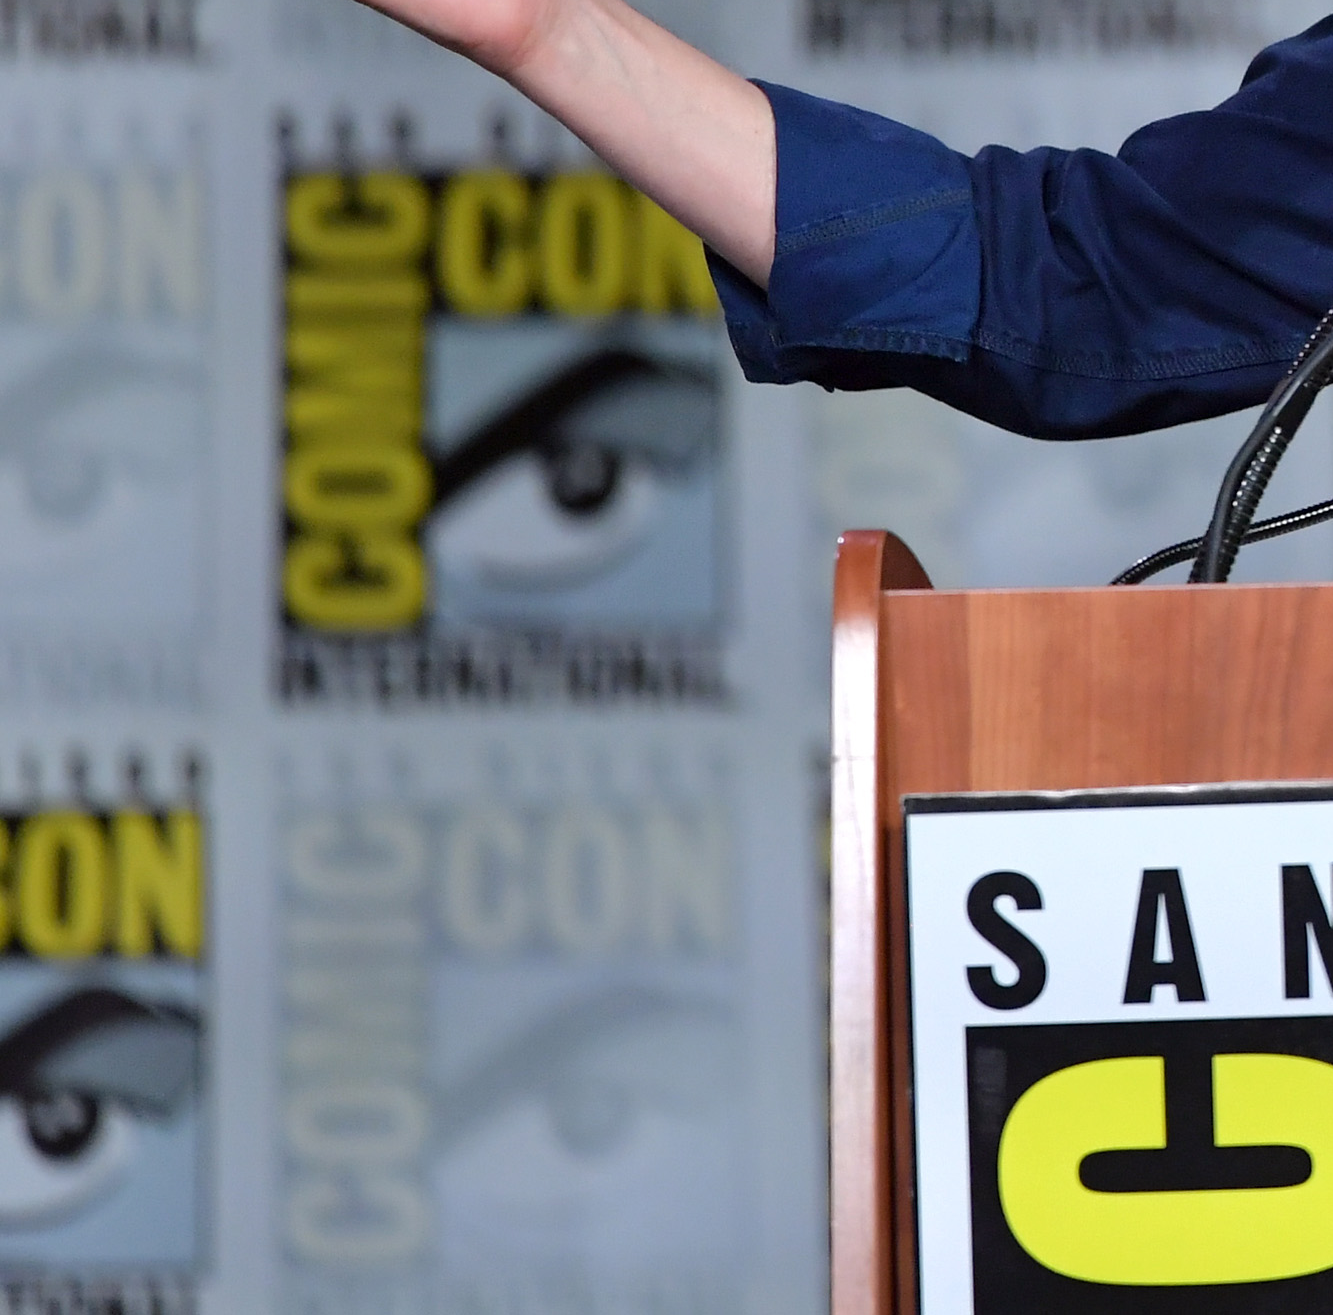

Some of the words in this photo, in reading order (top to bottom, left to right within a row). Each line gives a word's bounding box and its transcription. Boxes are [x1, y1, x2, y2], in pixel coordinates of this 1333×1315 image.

[0, 175, 196, 323] ON
[282, 170, 434, 631] COMIC
[0, 809, 202, 959] ON
